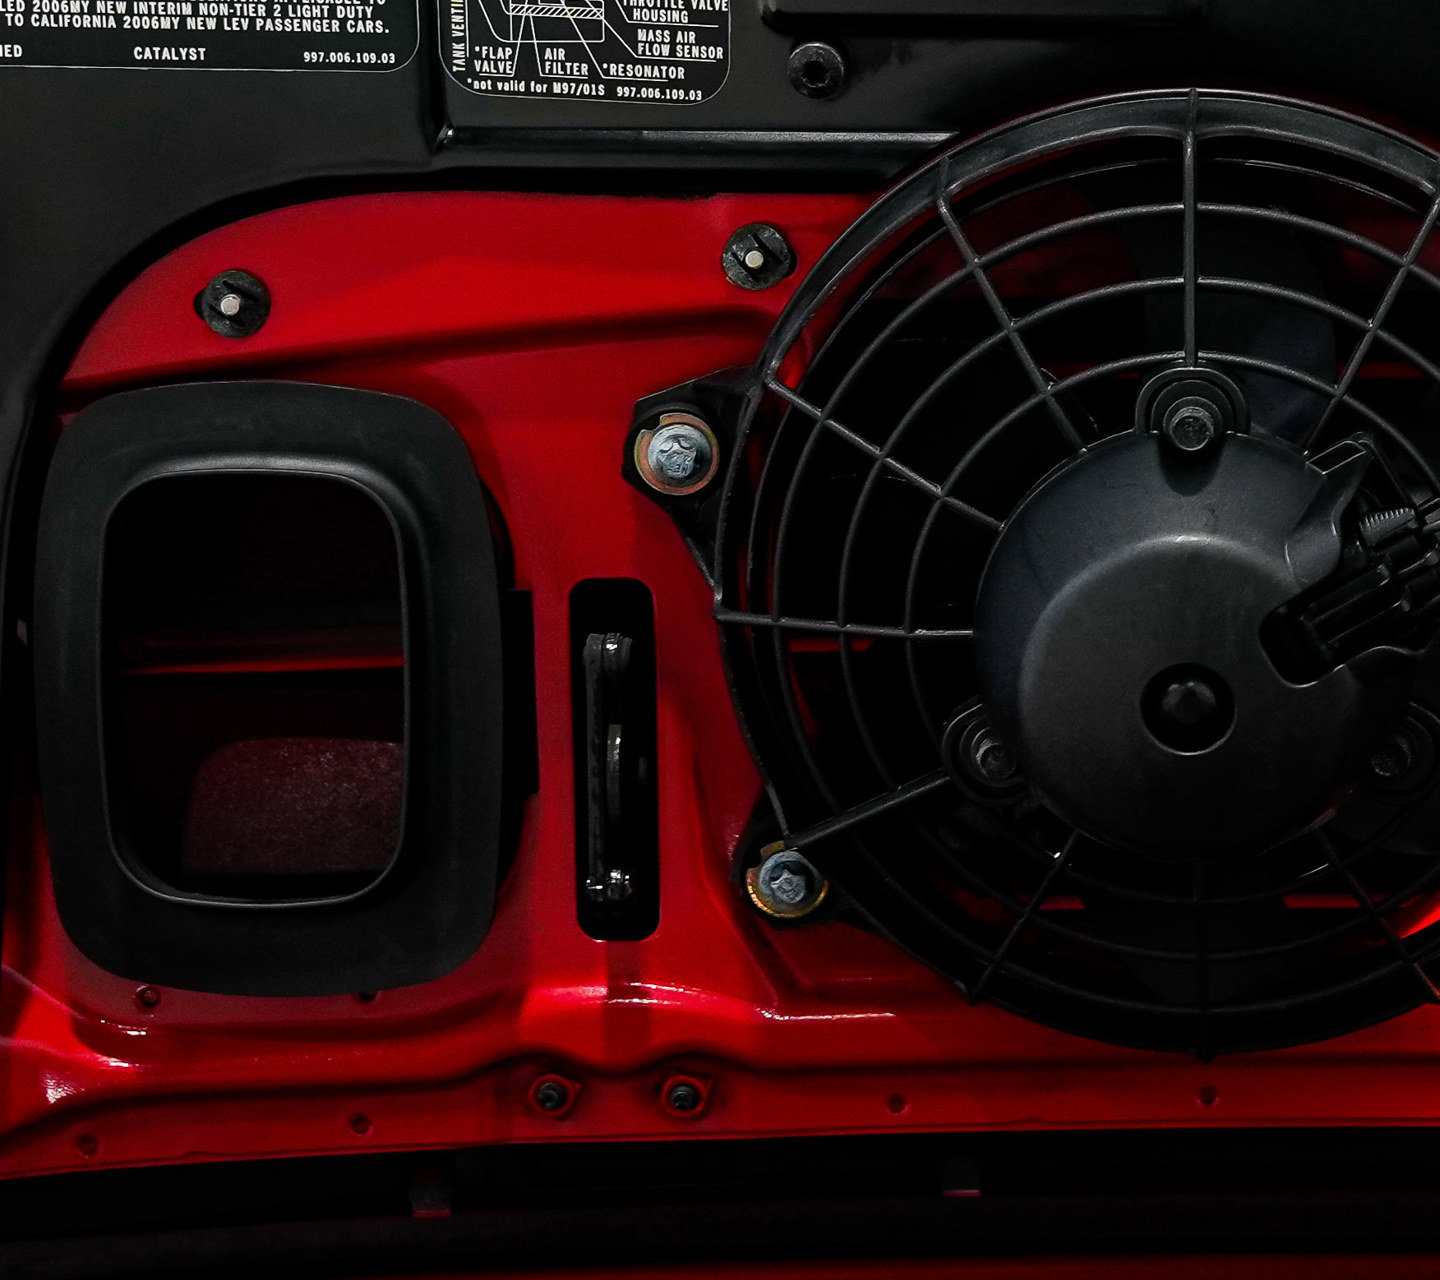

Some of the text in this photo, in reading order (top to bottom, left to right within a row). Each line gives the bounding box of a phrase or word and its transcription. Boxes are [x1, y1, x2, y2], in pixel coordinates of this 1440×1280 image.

[633, 8, 688, 23] HOUSING
[5, 13, 24, 27] TO
[31, 13, 116, 28] CALIFORNIA
[186, 17, 217, 30] NEW
[223, 17, 249, 31] LEV
[256, 18, 340, 32] PASSENGER
[347, 20, 389, 33] CARS.
[638, 29, 695, 43] MASS AIR
[134, 46, 206, 61] CATALYST
[304, 51, 395, 64] 997.006.109.03
[452, 43, 465, 72] TANK
[545, 48, 565, 60] AIR
[638, 43, 723, 59] FLOW SENSOR
[474, 60, 513, 74] VALVE
[545, 61, 588, 75] FILTER
[497, 80, 525, 92] valid
[530, 81, 547, 93] for
[553, 82, 604, 96] M97/01S
[617, 86, 702, 100] 997.006.109.03
